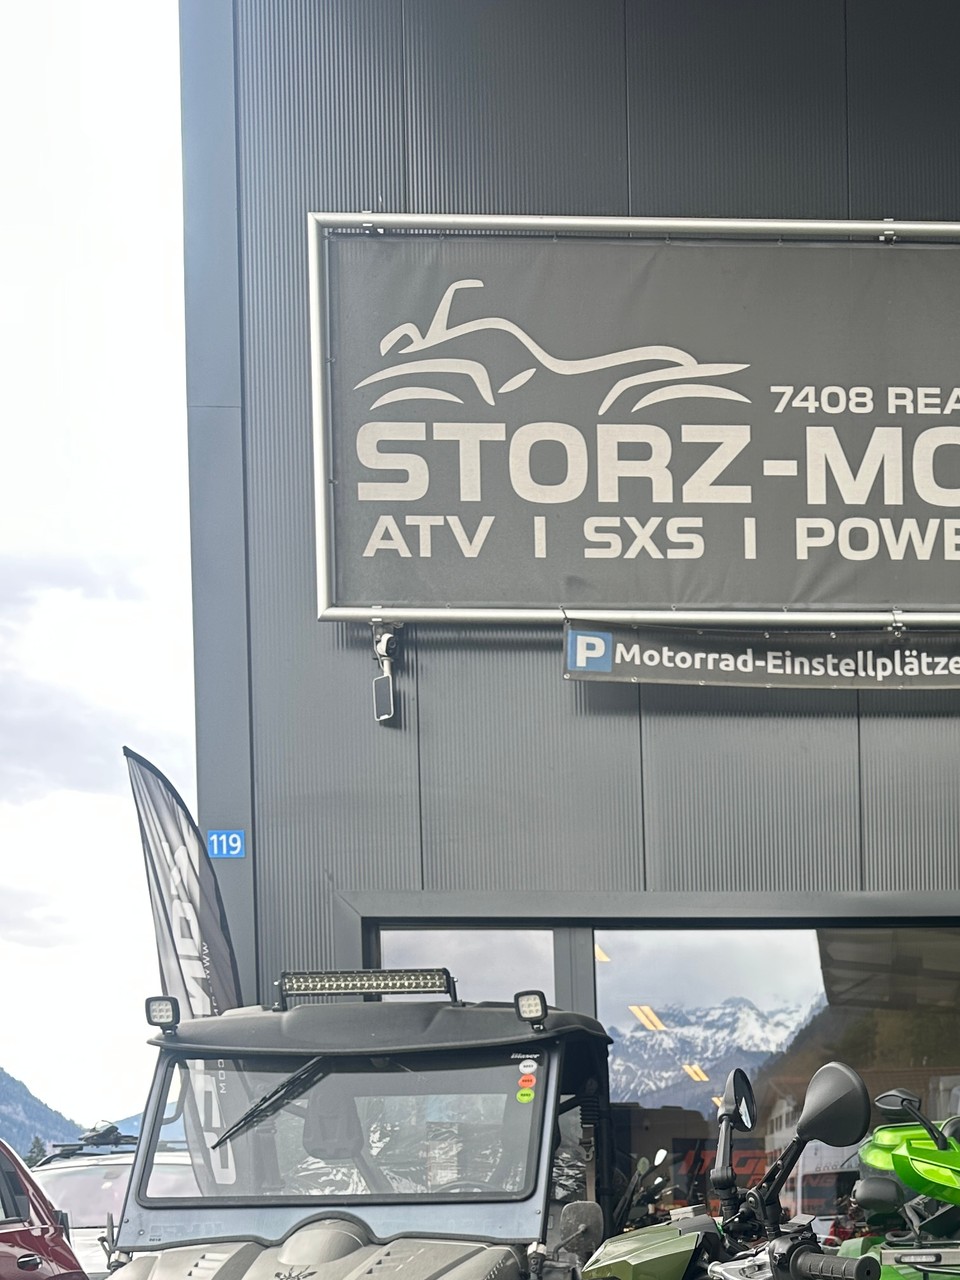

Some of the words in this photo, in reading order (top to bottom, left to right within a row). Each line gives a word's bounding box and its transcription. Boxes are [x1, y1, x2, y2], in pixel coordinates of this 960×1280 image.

[770, 385, 875, 414] 7408
[361, 514, 496, 558] ATV
[583, 516, 705, 560] SXS
[209, 833, 242, 855] 119
